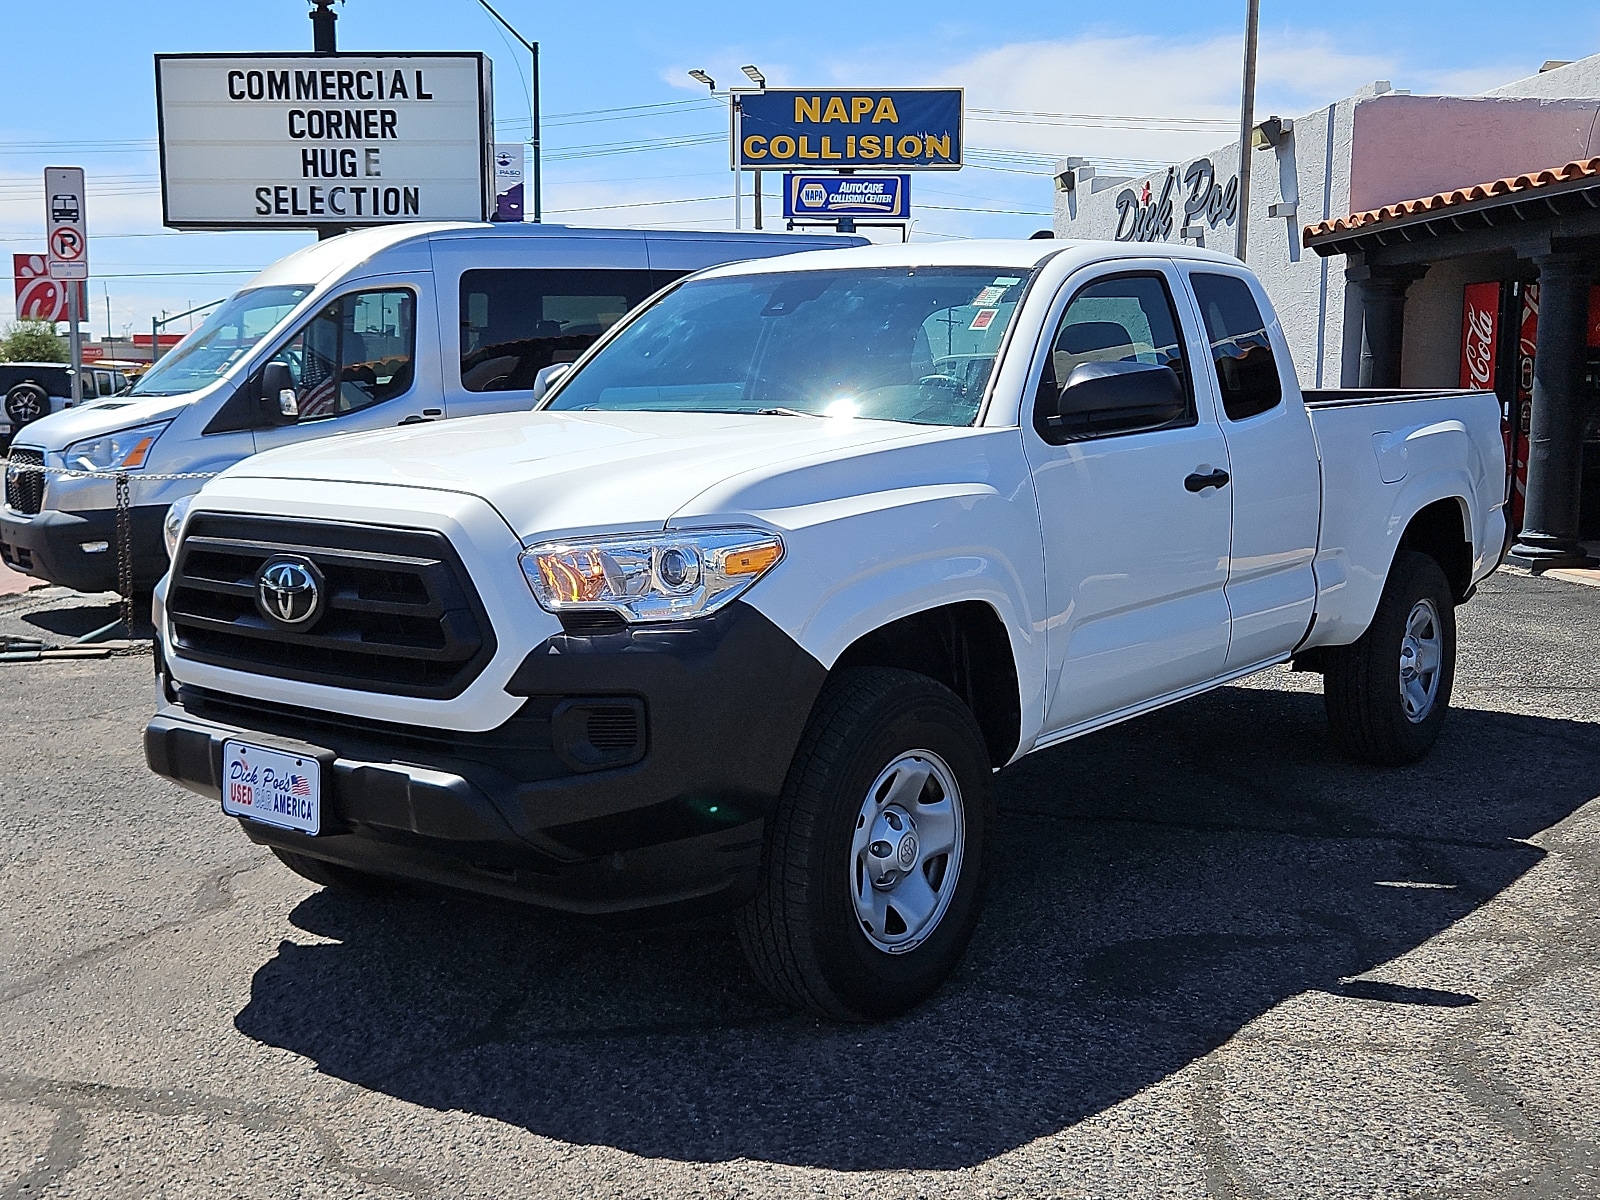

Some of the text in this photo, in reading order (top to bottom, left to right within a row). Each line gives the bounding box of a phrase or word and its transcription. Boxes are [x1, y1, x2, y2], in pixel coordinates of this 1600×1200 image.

[227, 69, 433, 100] COMMERCIAL
[288, 109, 398, 139] CORNER
[794, 96, 899, 123] NAPA
[743, 134, 951, 159] COLLISION
[301, 148, 381, 178] HUGE
[255, 186, 419, 216] SELECTION
[804, 189, 823, 201] NAPA
[828, 193, 893, 203] COLLISION CENTER
[1115, 157, 1239, 242] Dick Poe
[231, 760, 292, 793] Dick Poe's
[230, 782, 253, 805] USED
[273, 793, 313, 821] AMERICA
